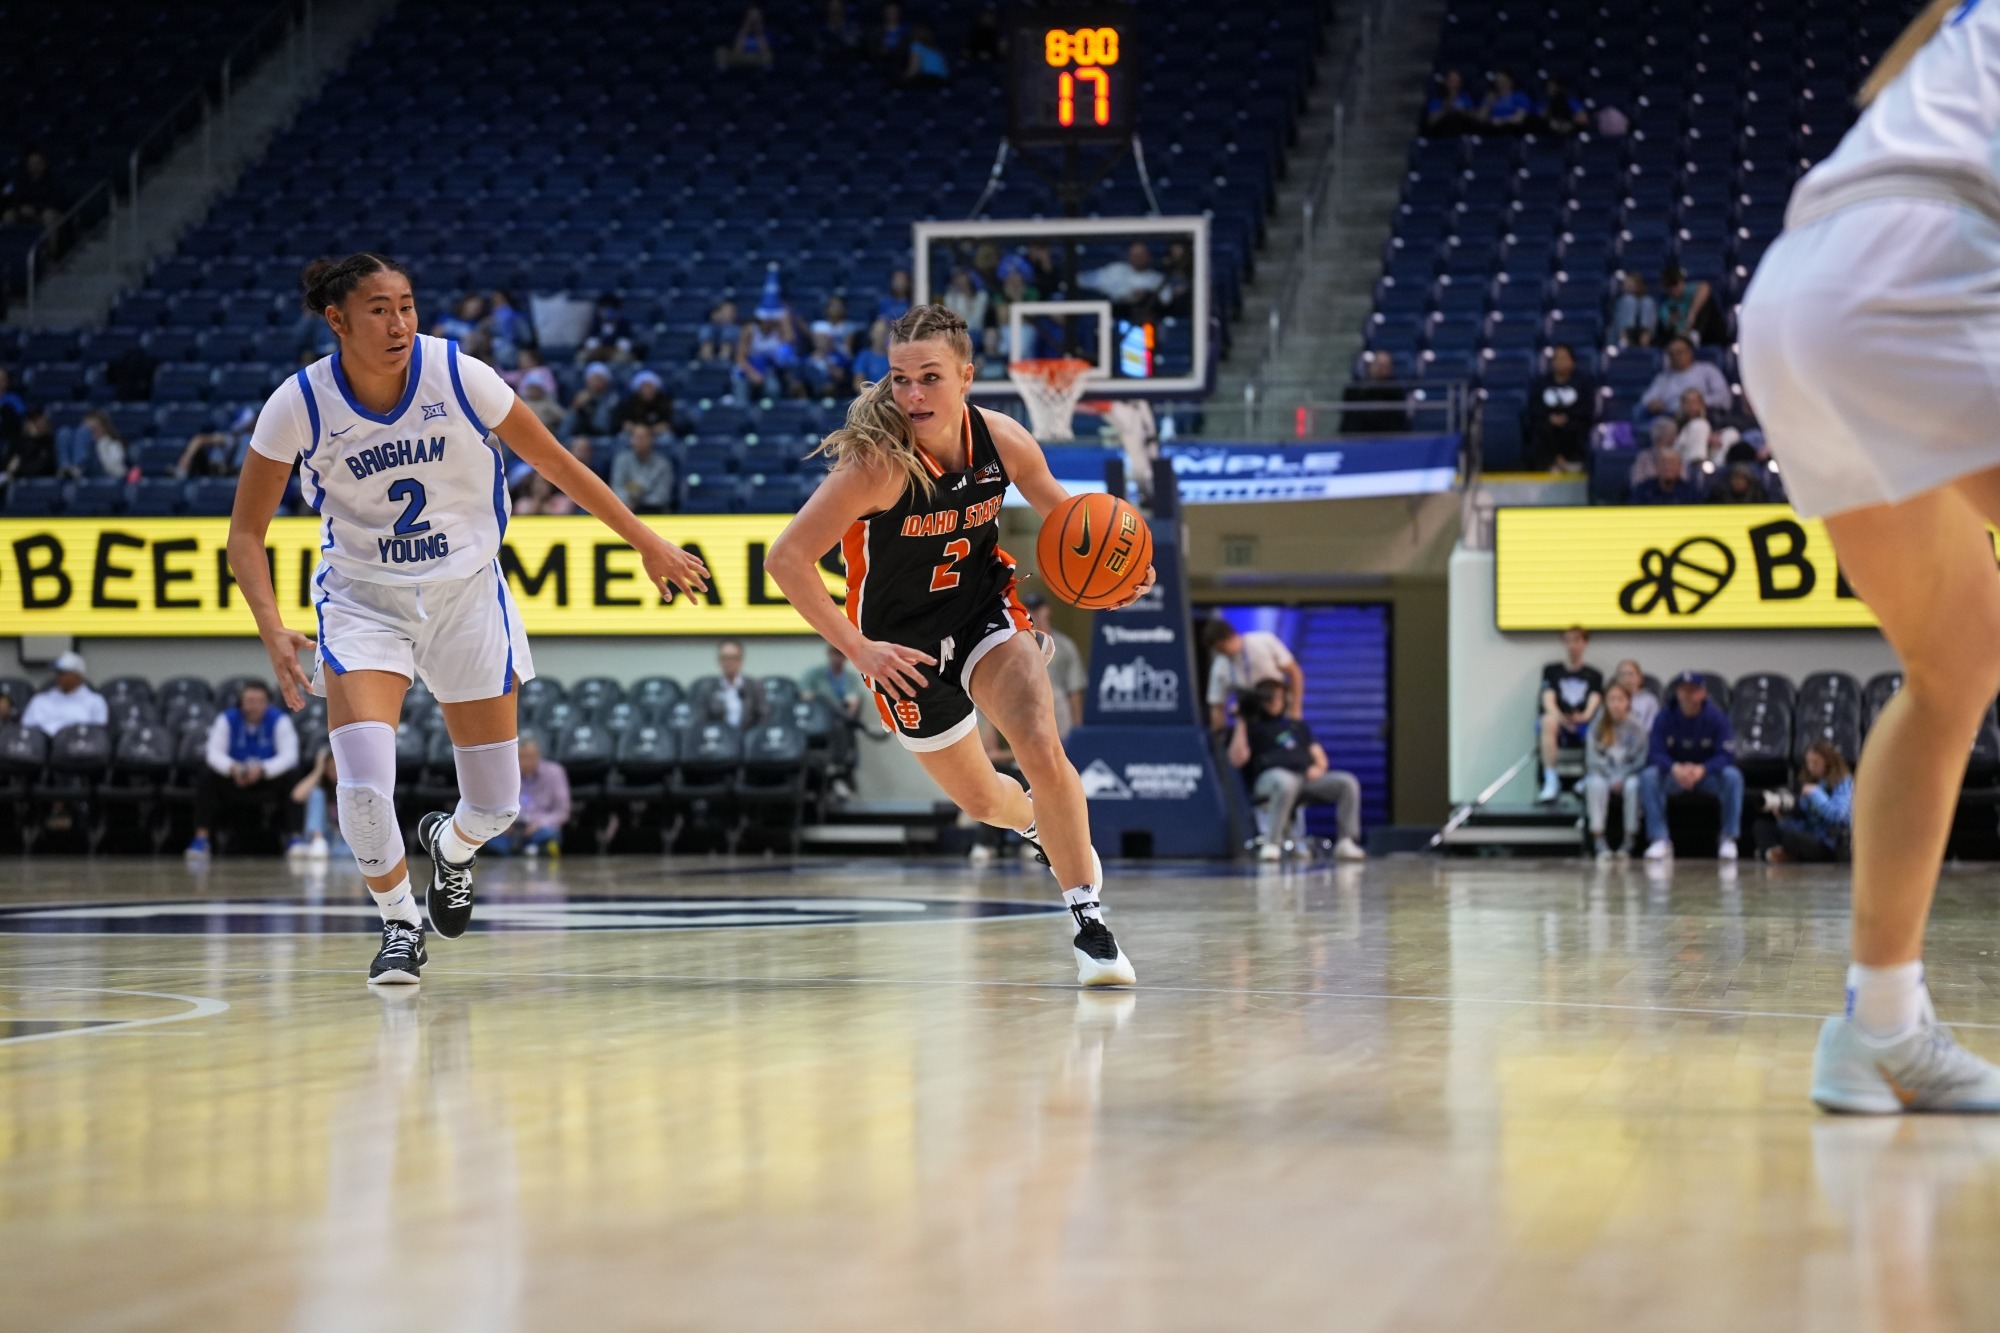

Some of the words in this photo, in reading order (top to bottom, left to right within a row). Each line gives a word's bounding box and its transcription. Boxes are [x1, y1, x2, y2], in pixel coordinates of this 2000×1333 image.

[1045, 27, 1120, 67] 8:00
[1058, 66, 1110, 127] 17
[345, 436, 446, 480] BRIGHAM
[387, 477, 431, 537] 2
[900, 510, 959, 537] IDAHO
[12, 531, 314, 610] BEEHI
[378, 532, 449, 563] YOUNG
[929, 537, 971, 593] 2
[1104, 511, 1138, 574] ELITE
